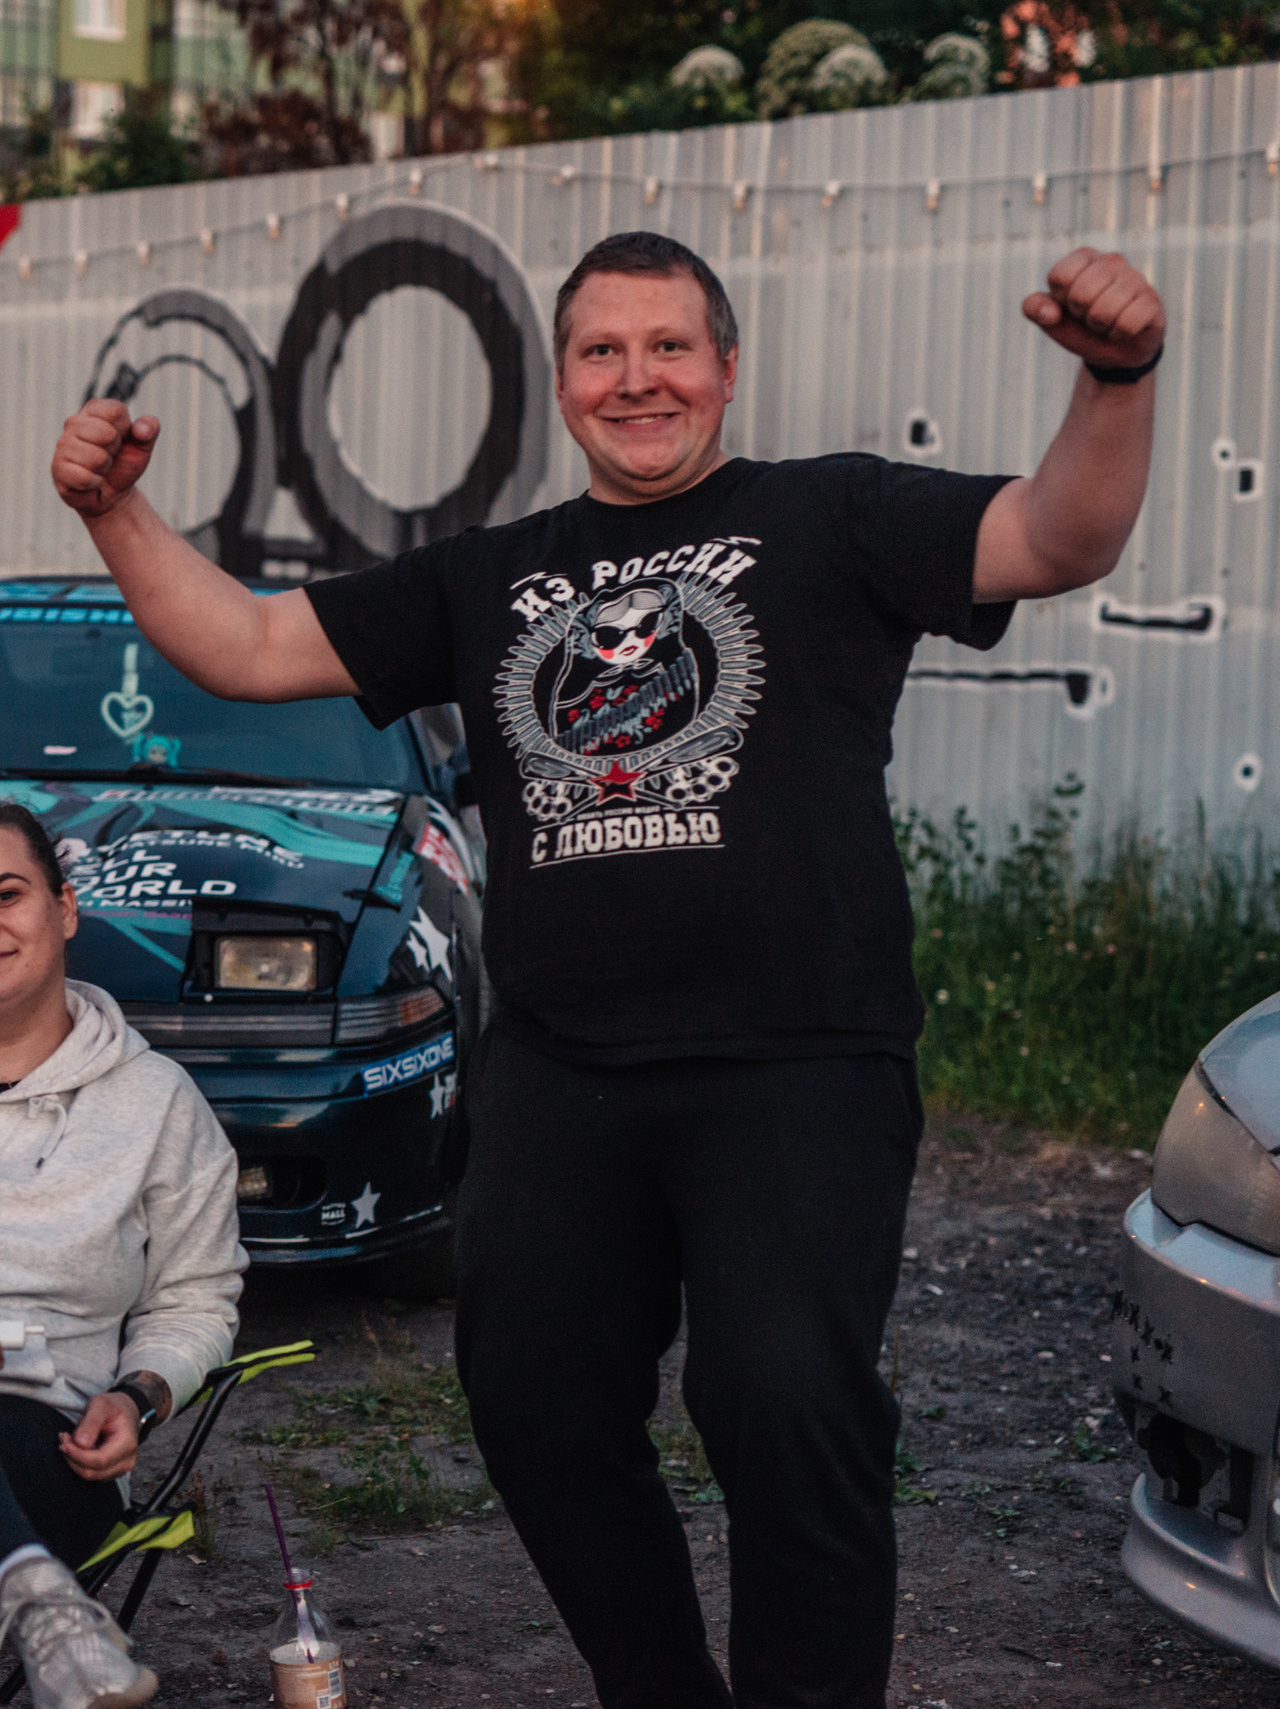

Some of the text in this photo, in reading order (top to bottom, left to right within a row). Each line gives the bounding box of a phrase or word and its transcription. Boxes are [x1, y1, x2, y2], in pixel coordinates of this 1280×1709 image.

[510, 543, 757, 622] ИЗ РОССИИ
[531, 813, 721, 863] С ЛЮБОВЬЮ
[363, 1036, 454, 1090] SIXSIXONE
